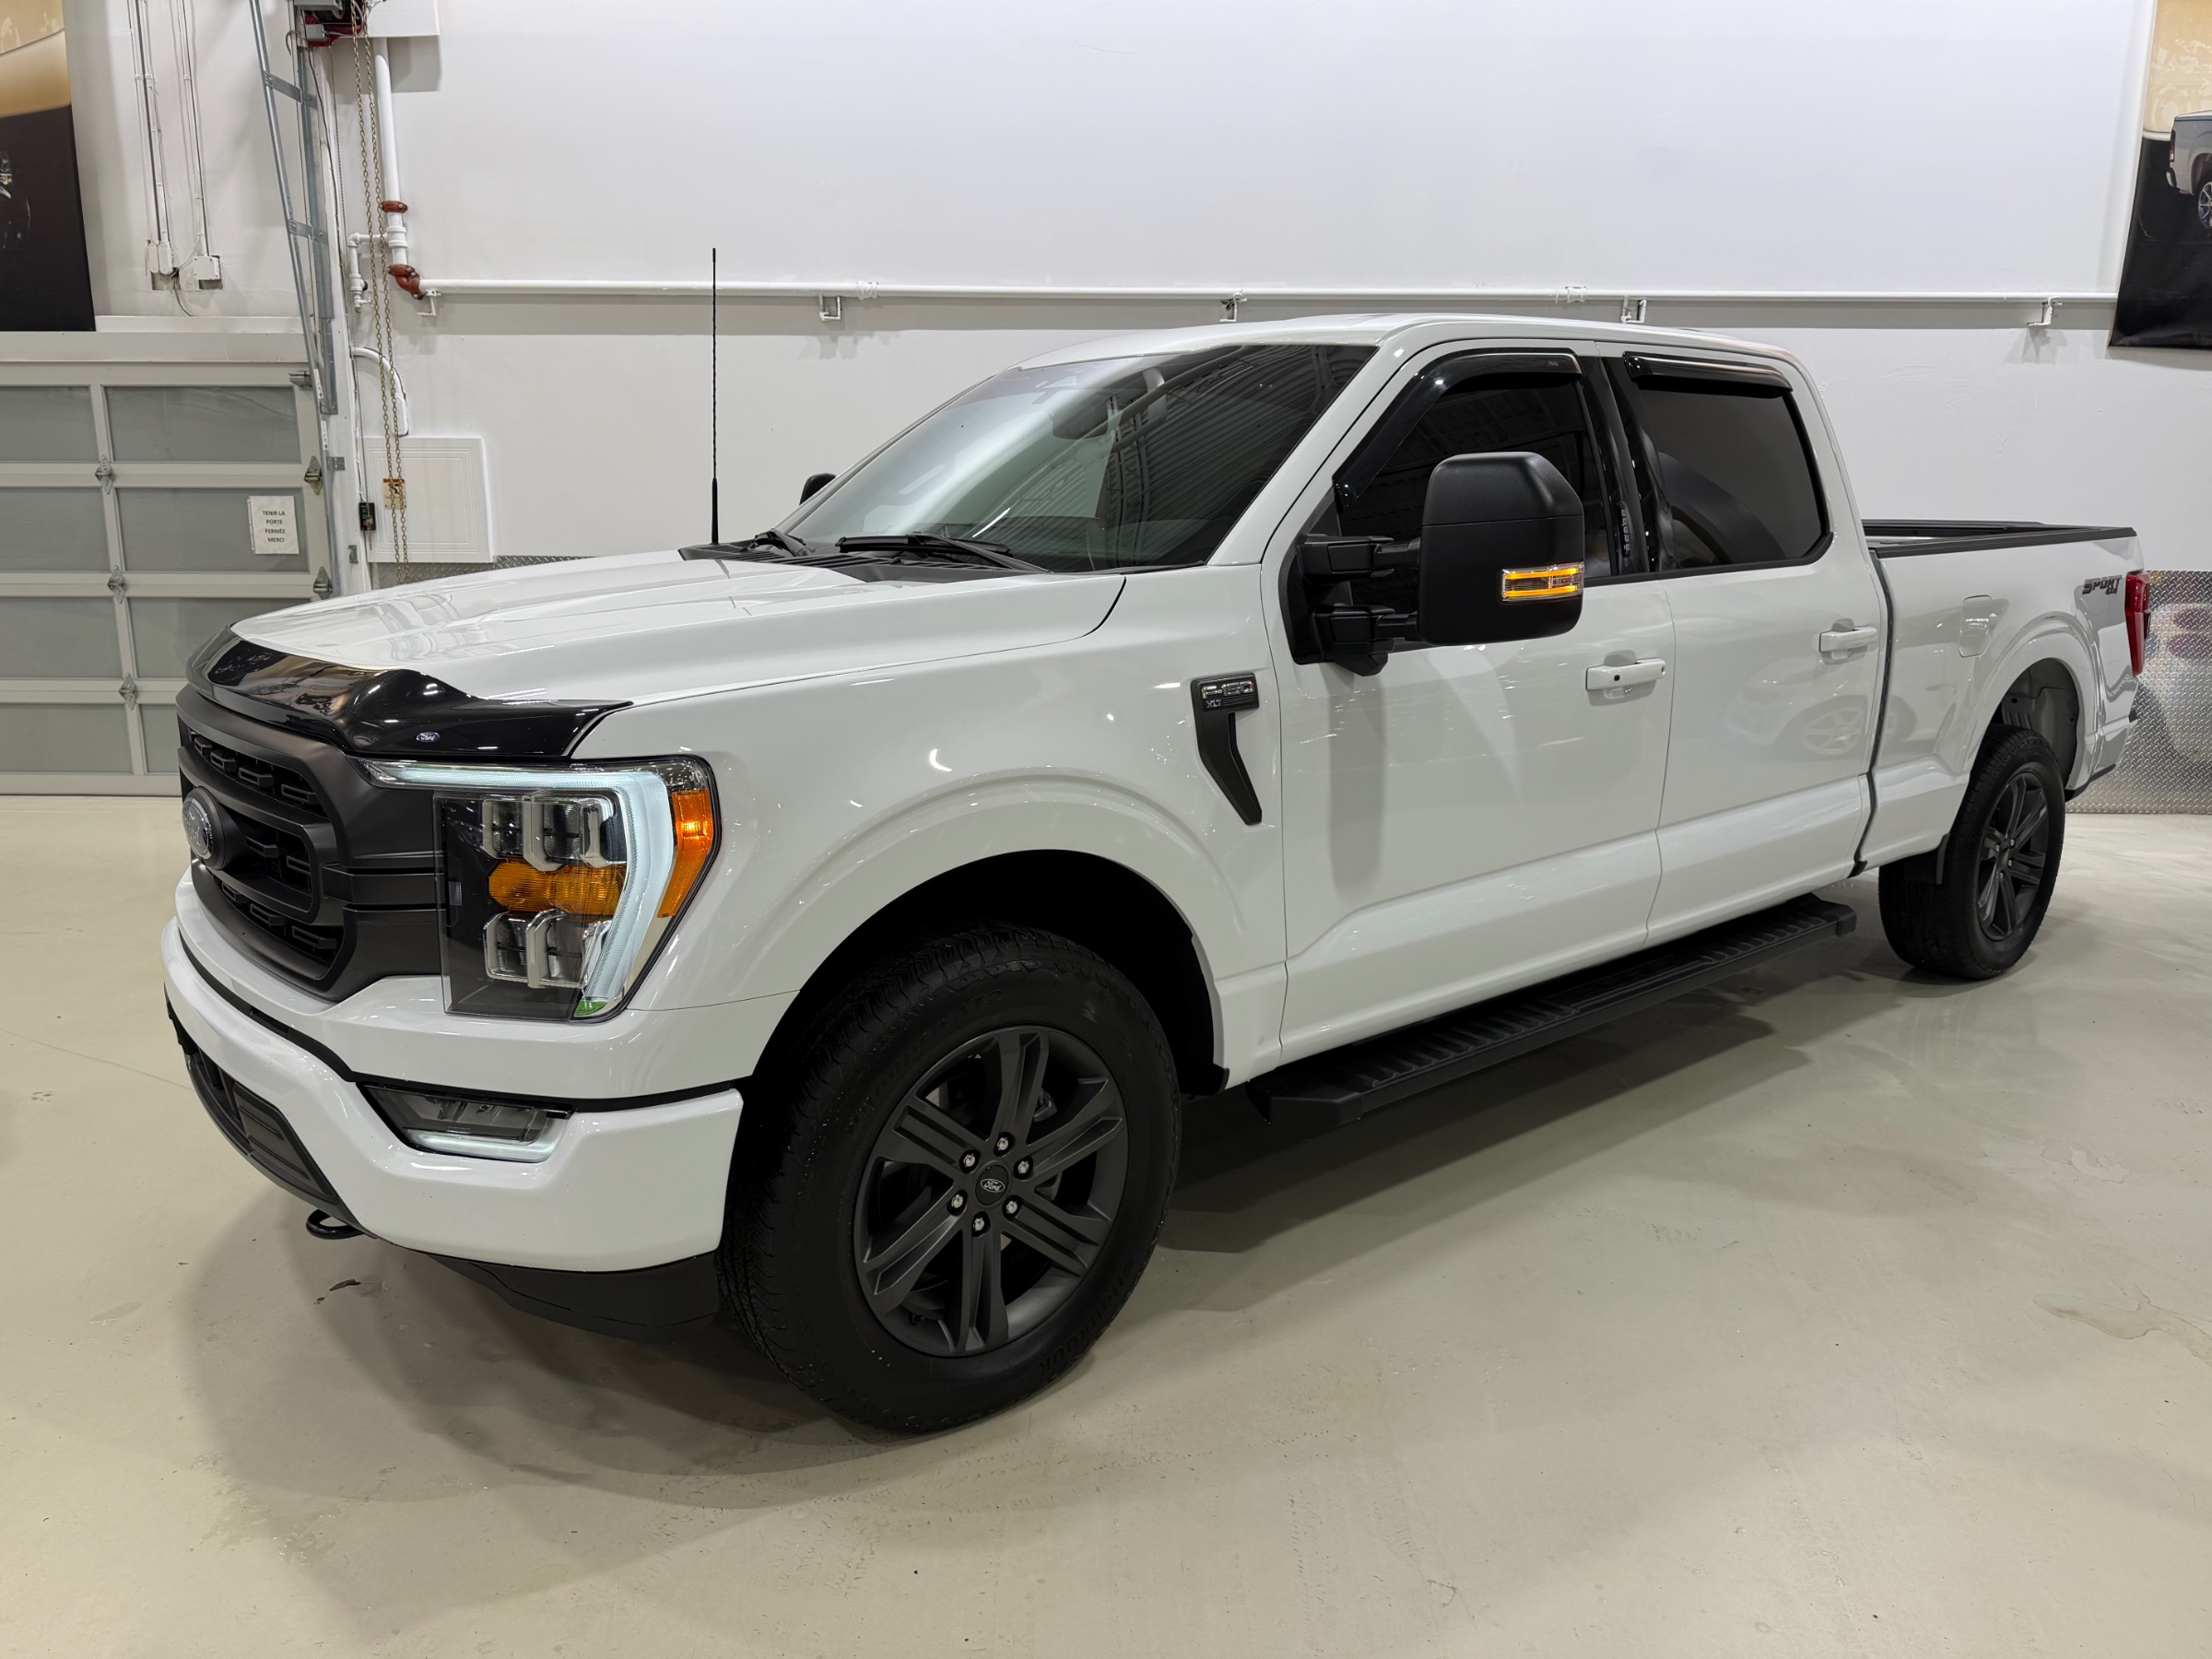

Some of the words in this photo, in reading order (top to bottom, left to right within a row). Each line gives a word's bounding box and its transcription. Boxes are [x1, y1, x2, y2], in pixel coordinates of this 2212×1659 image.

[2082, 574, 2123, 594] SPORT
[1201, 681, 1254, 699] F-150
[1206, 700, 1221, 708] XLT
